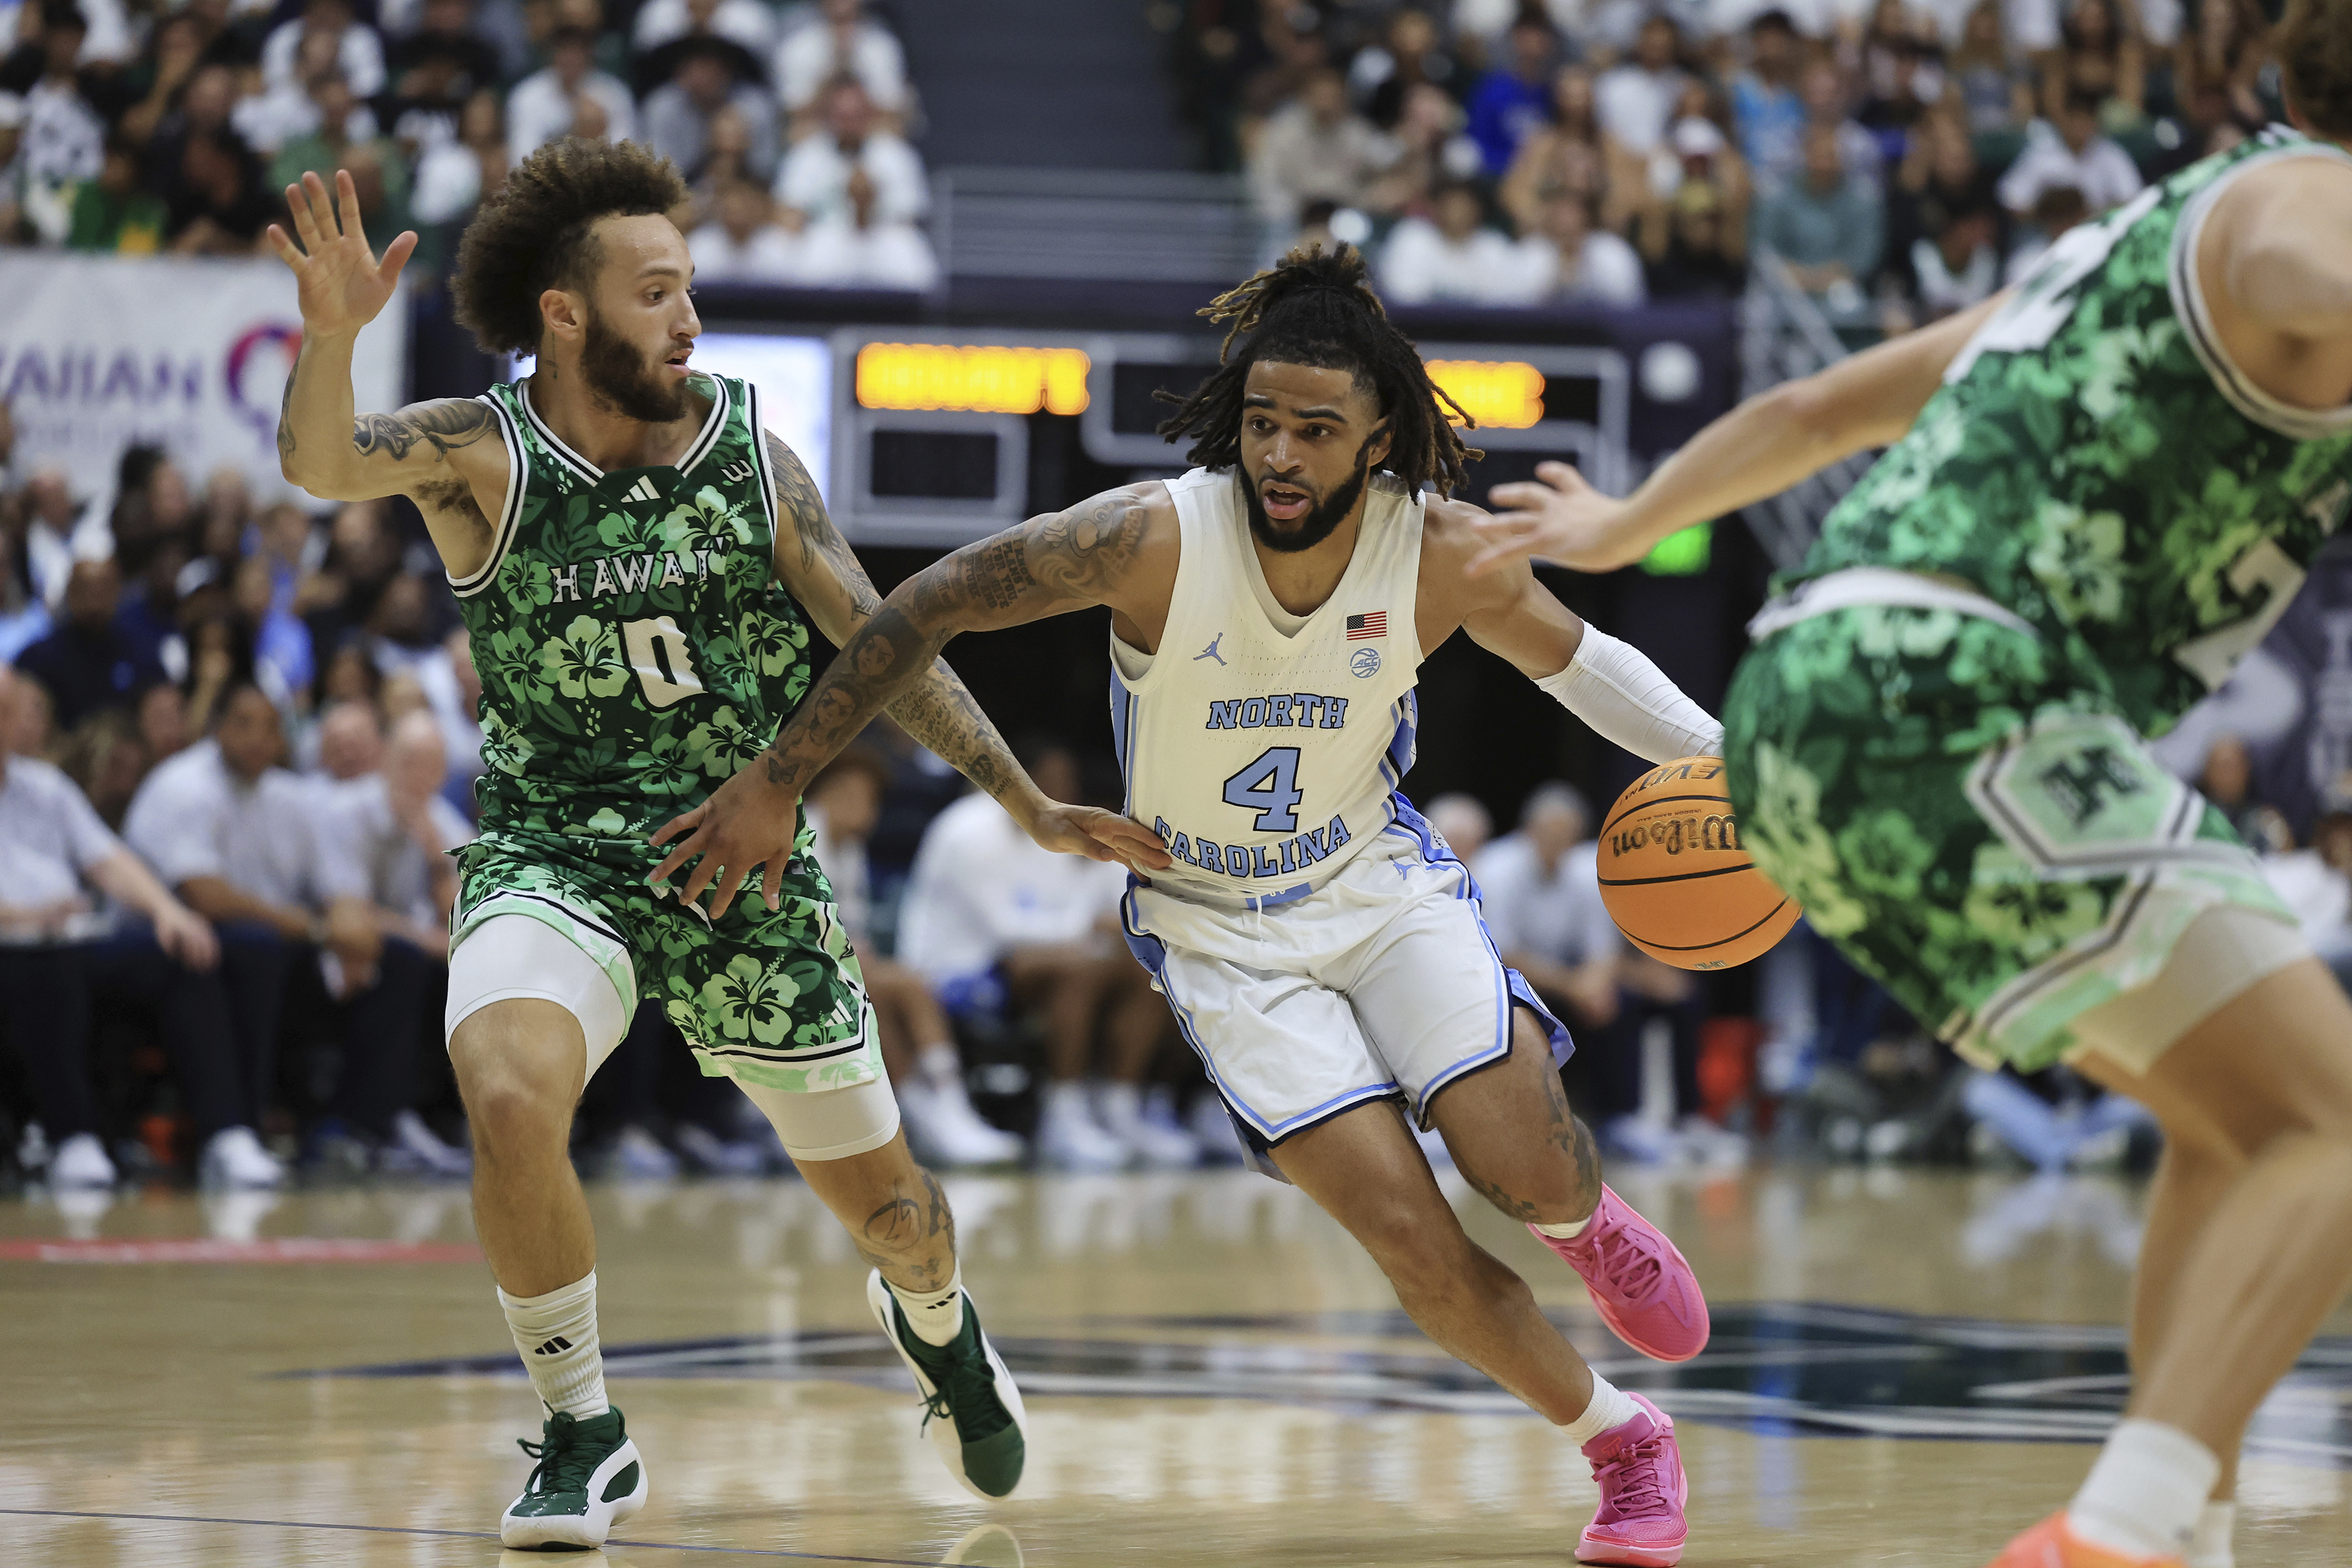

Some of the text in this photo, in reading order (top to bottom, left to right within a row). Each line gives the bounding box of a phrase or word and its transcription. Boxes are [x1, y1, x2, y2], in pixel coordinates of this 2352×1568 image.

[0, 343, 203, 406] AIIAN
[1002, 540, 1023, 584] PLANS
[621, 613, 710, 709] 0
[1206, 693, 1348, 730] NORTH
[1222, 746, 1303, 833] 4
[1154, 813, 1352, 878] CAROLINA
[1612, 814, 1743, 857] Wilson
